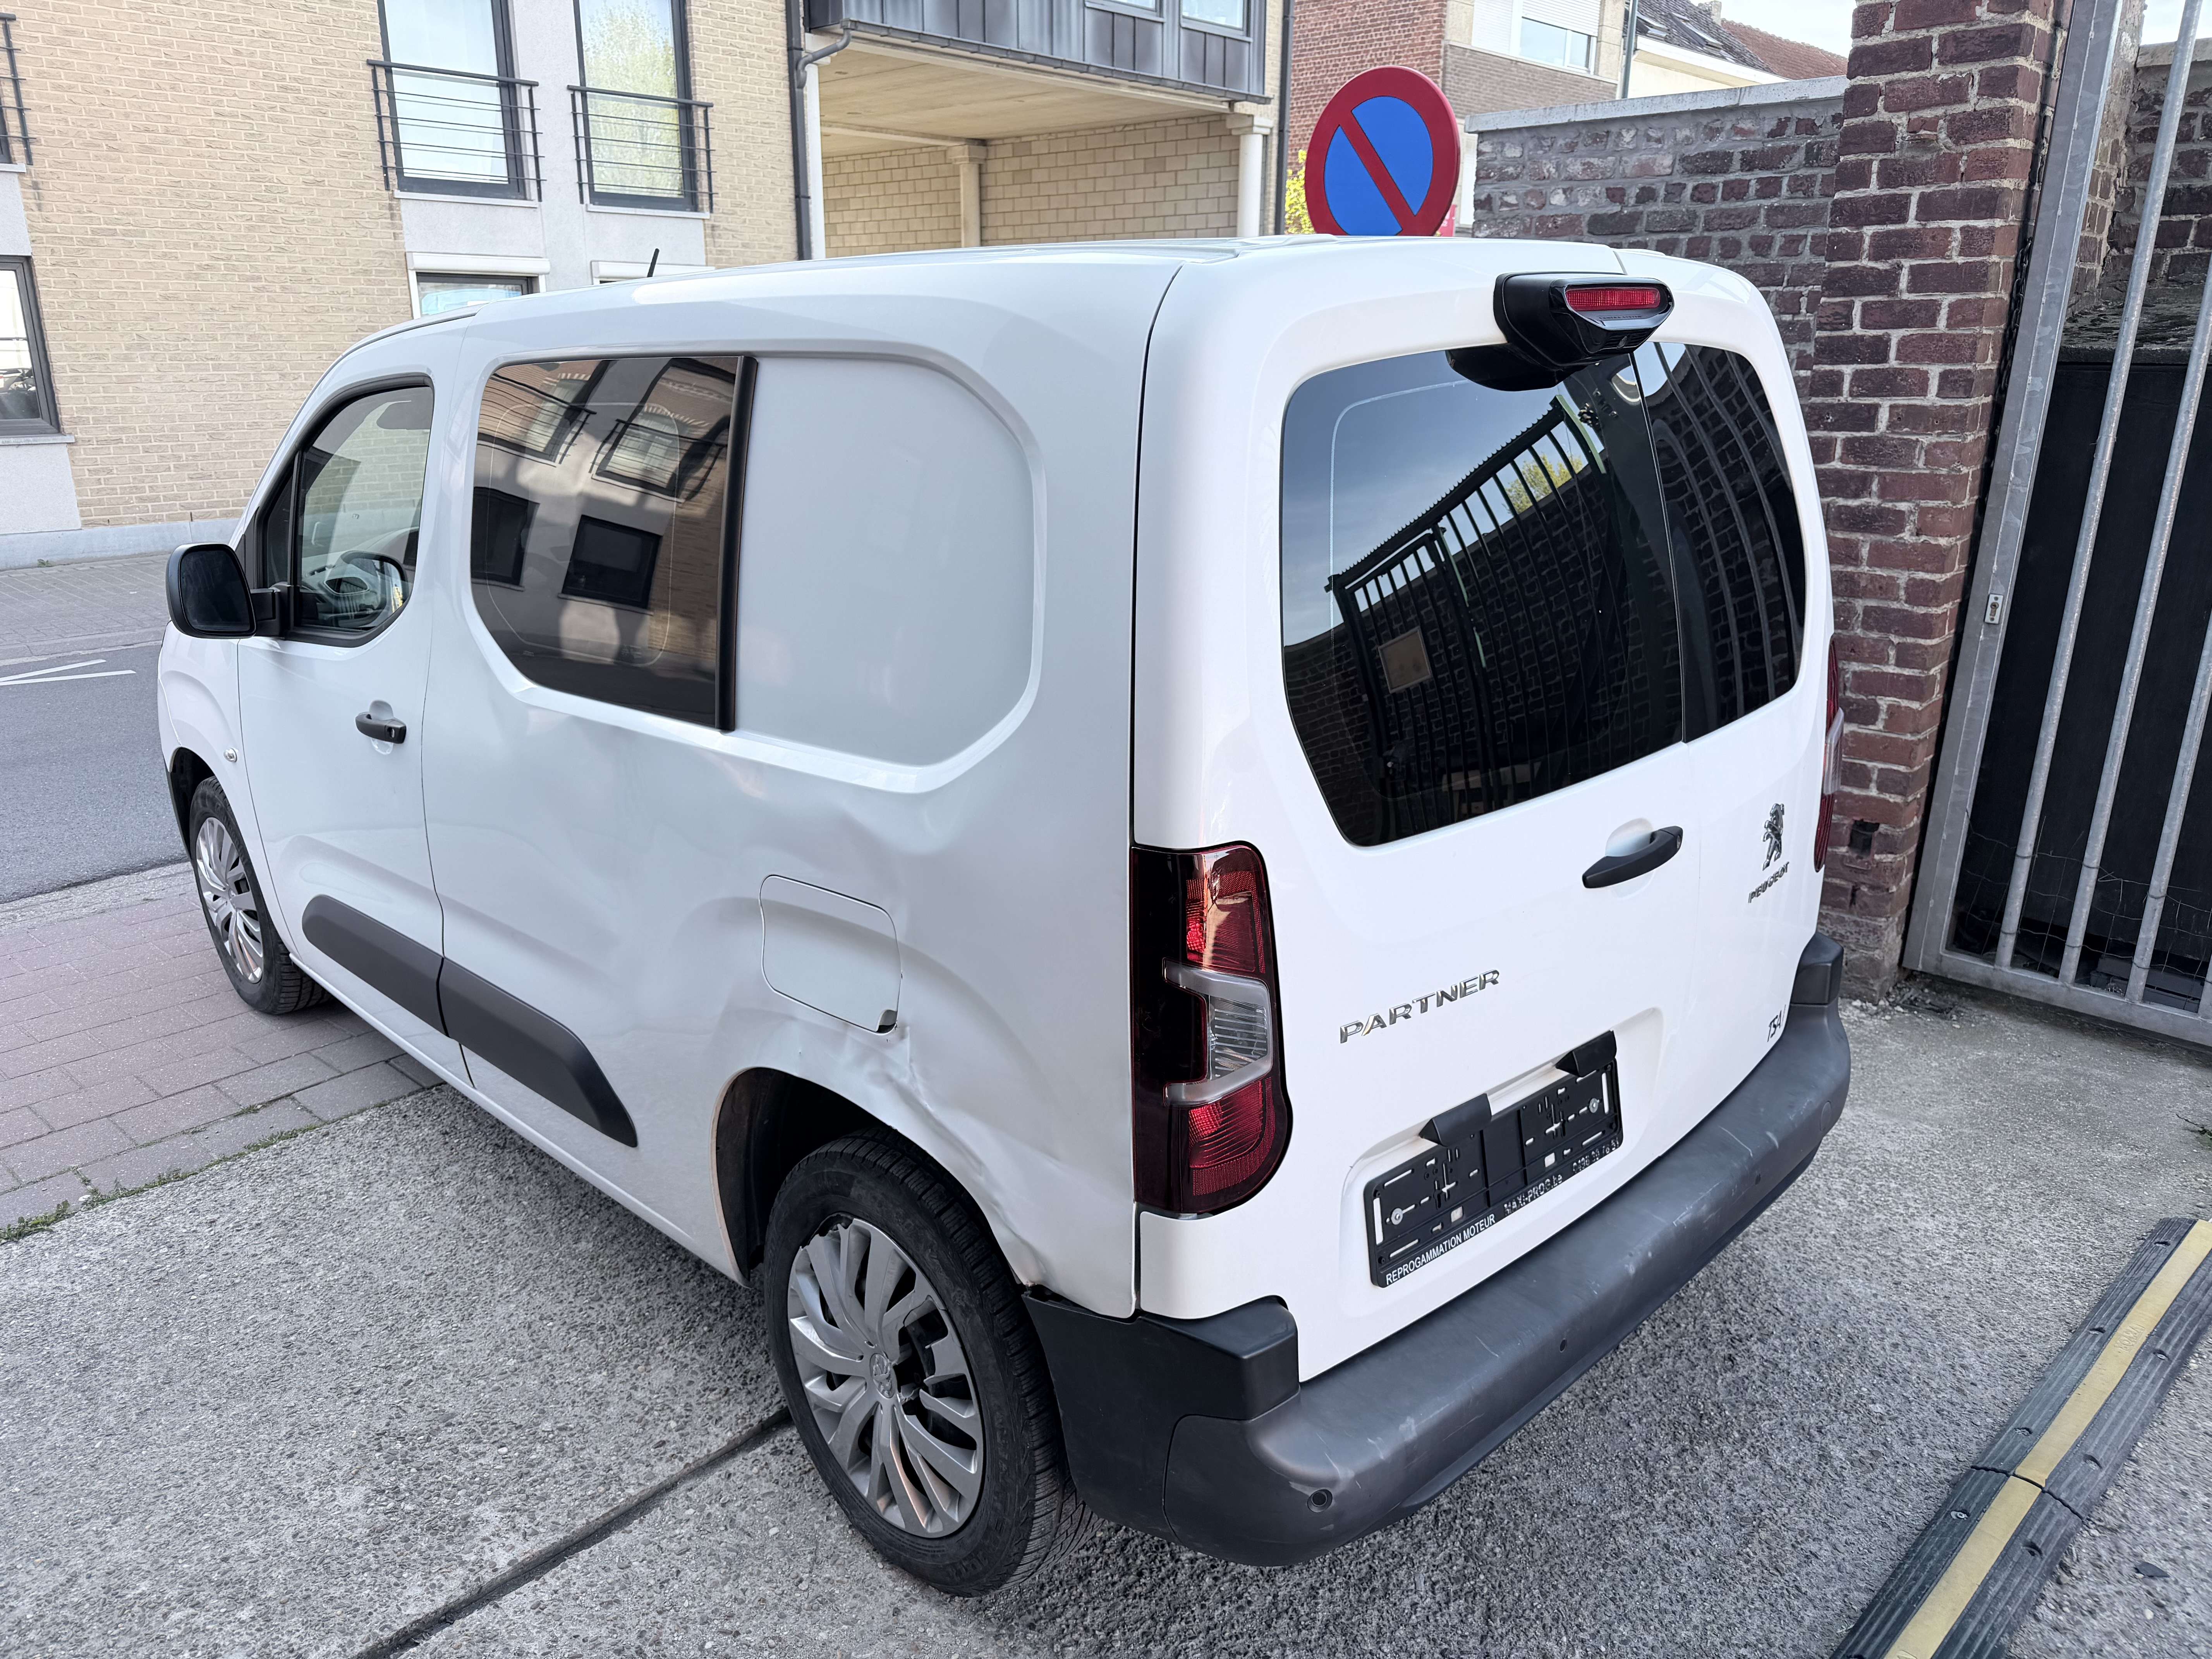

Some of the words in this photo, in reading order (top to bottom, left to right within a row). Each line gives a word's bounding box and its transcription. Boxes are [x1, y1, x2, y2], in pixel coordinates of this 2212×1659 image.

[1748, 861, 1790, 903] PEUGEOT
[1340, 969, 1499, 1044] PARTNER
[1386, 1234, 1462, 1285] REPROGAMMATION
[1463, 1214, 1496, 1240] MOTEUR
